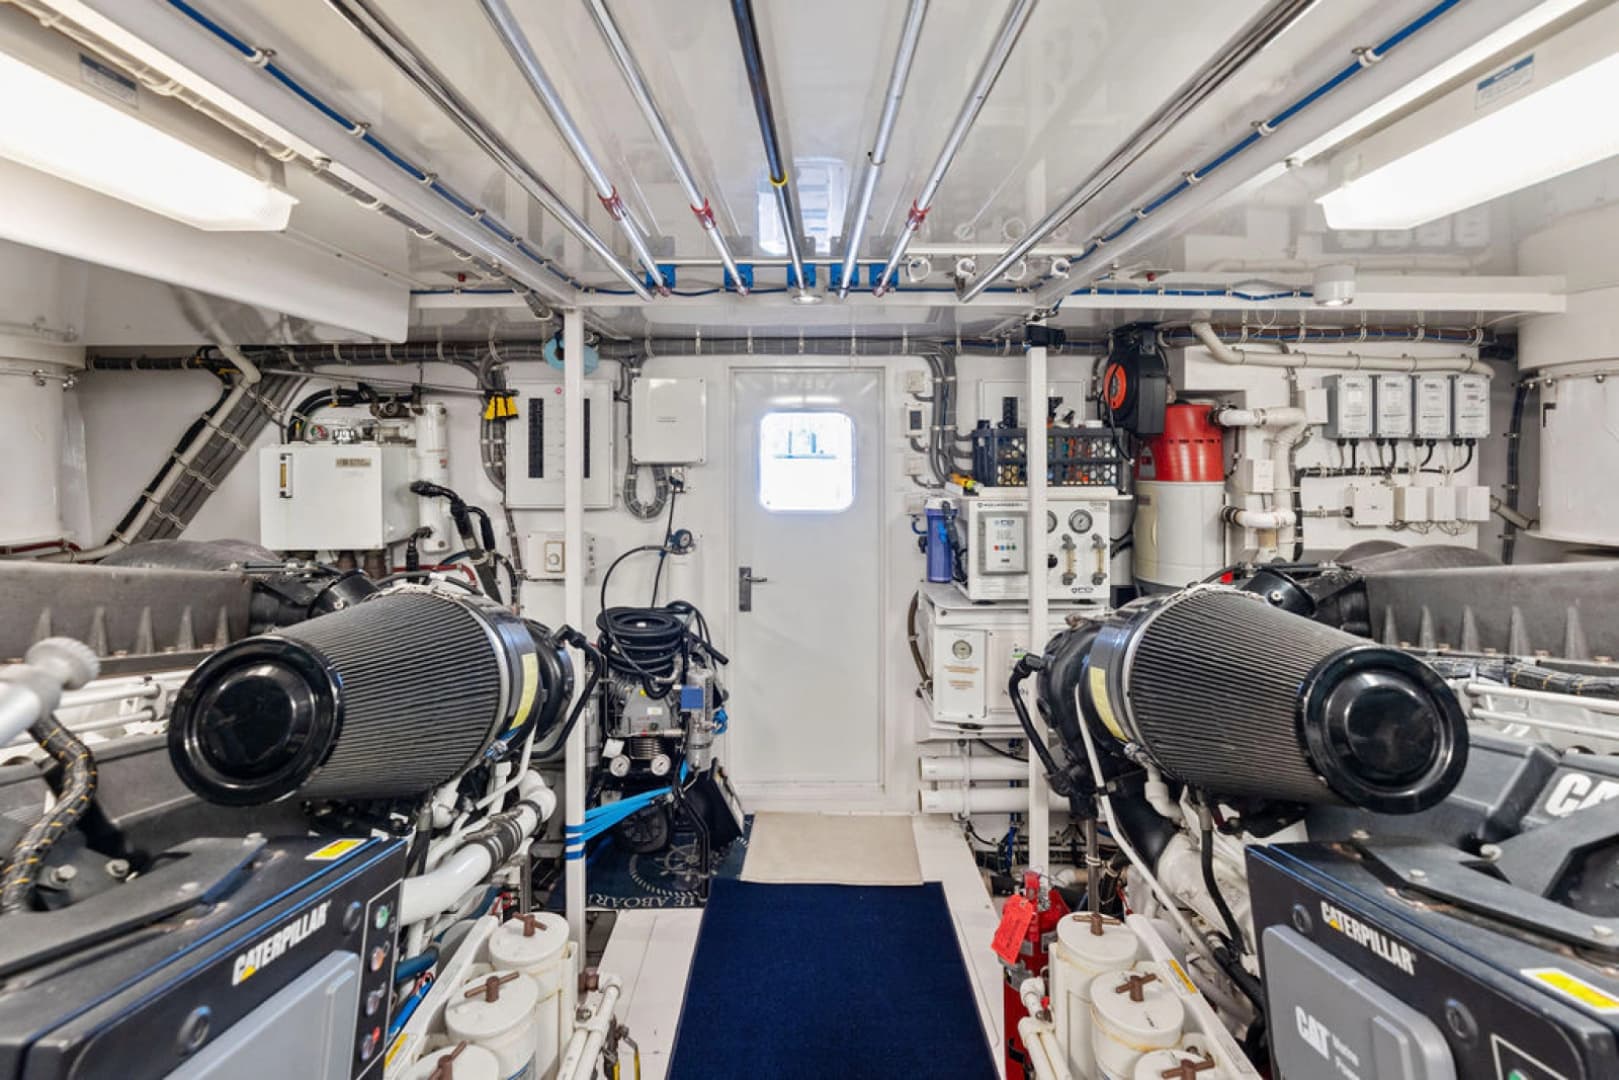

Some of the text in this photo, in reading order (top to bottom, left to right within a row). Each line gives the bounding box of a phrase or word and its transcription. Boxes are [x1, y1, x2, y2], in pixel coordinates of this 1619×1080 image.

[232, 902, 329, 986] CATERPILLAR
[1320, 901, 1415, 976] CATERPILLAR
[1295, 1006, 1330, 1061] CAT
